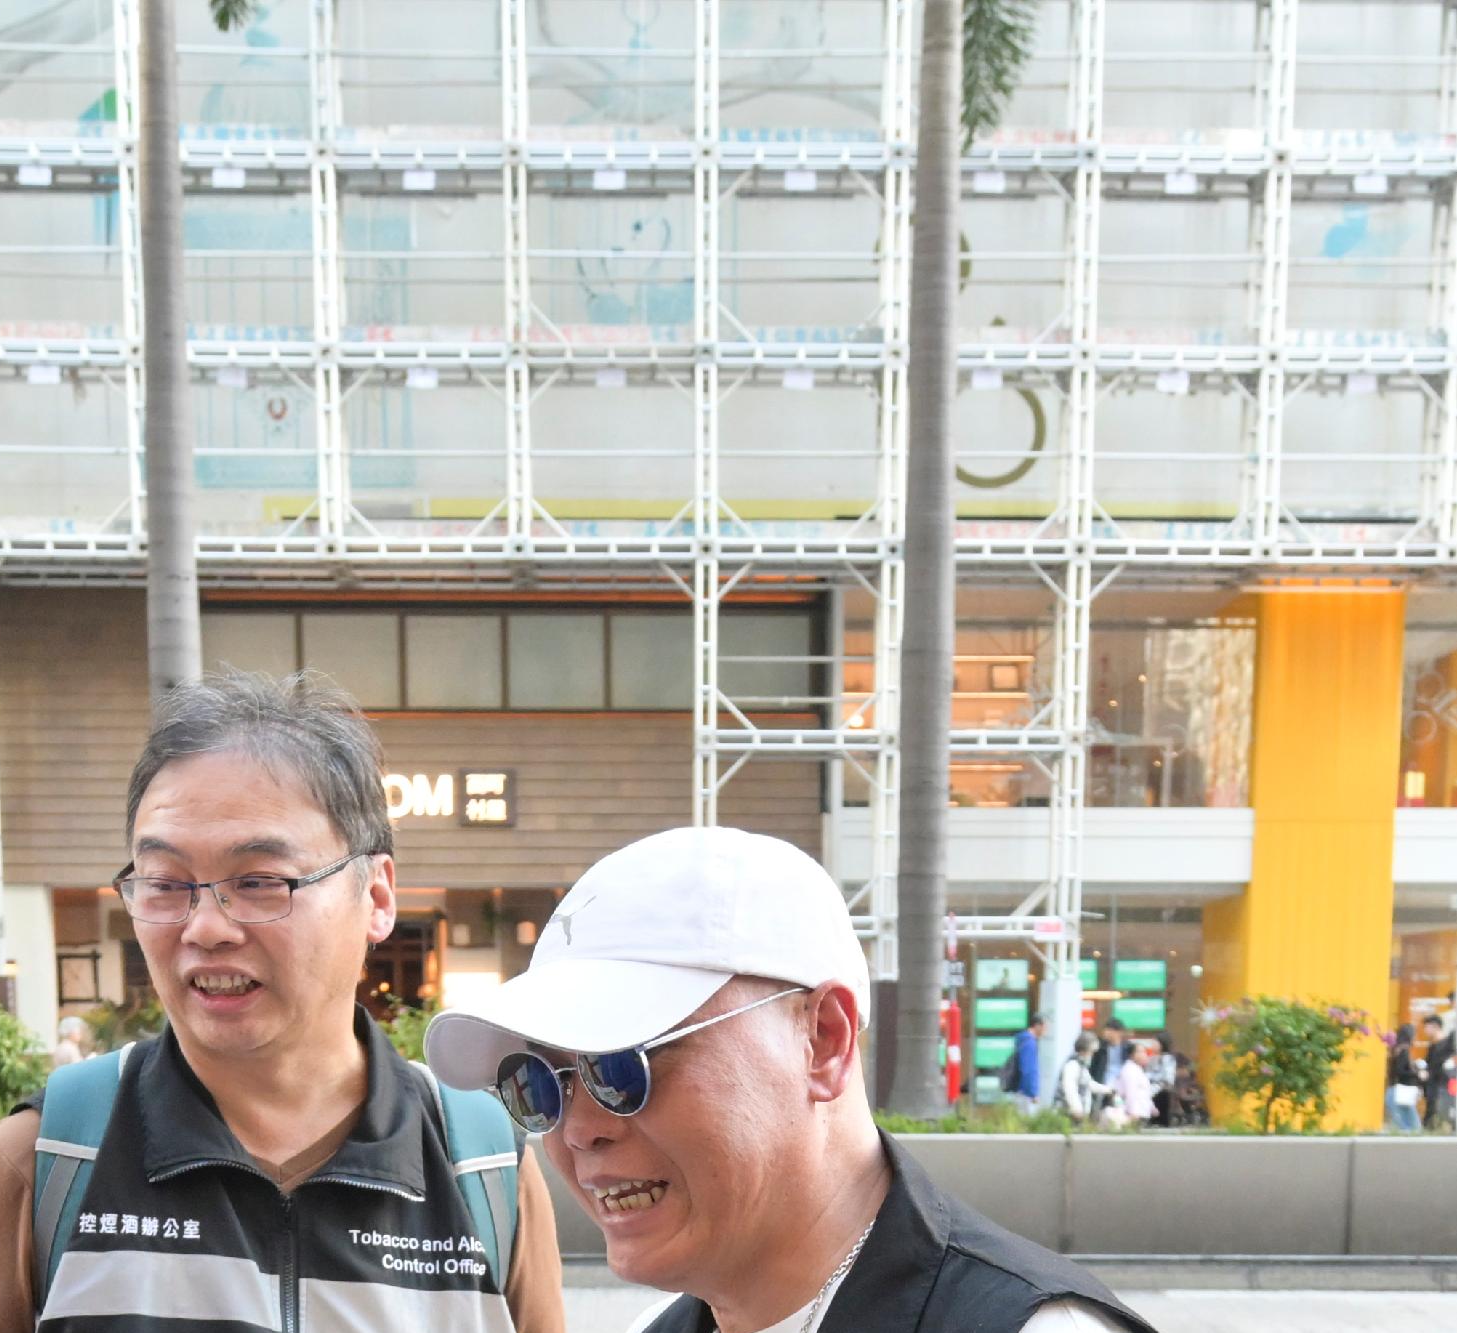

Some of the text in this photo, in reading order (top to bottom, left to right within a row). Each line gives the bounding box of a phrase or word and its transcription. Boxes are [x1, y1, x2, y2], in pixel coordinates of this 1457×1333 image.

[381, 773, 454, 819] OM
[79, 1211, 201, 1239] 控煙酒辦公室
[348, 1229, 485, 1253] Tobacco and Alc
[381, 1253, 486, 1276] Control Office
